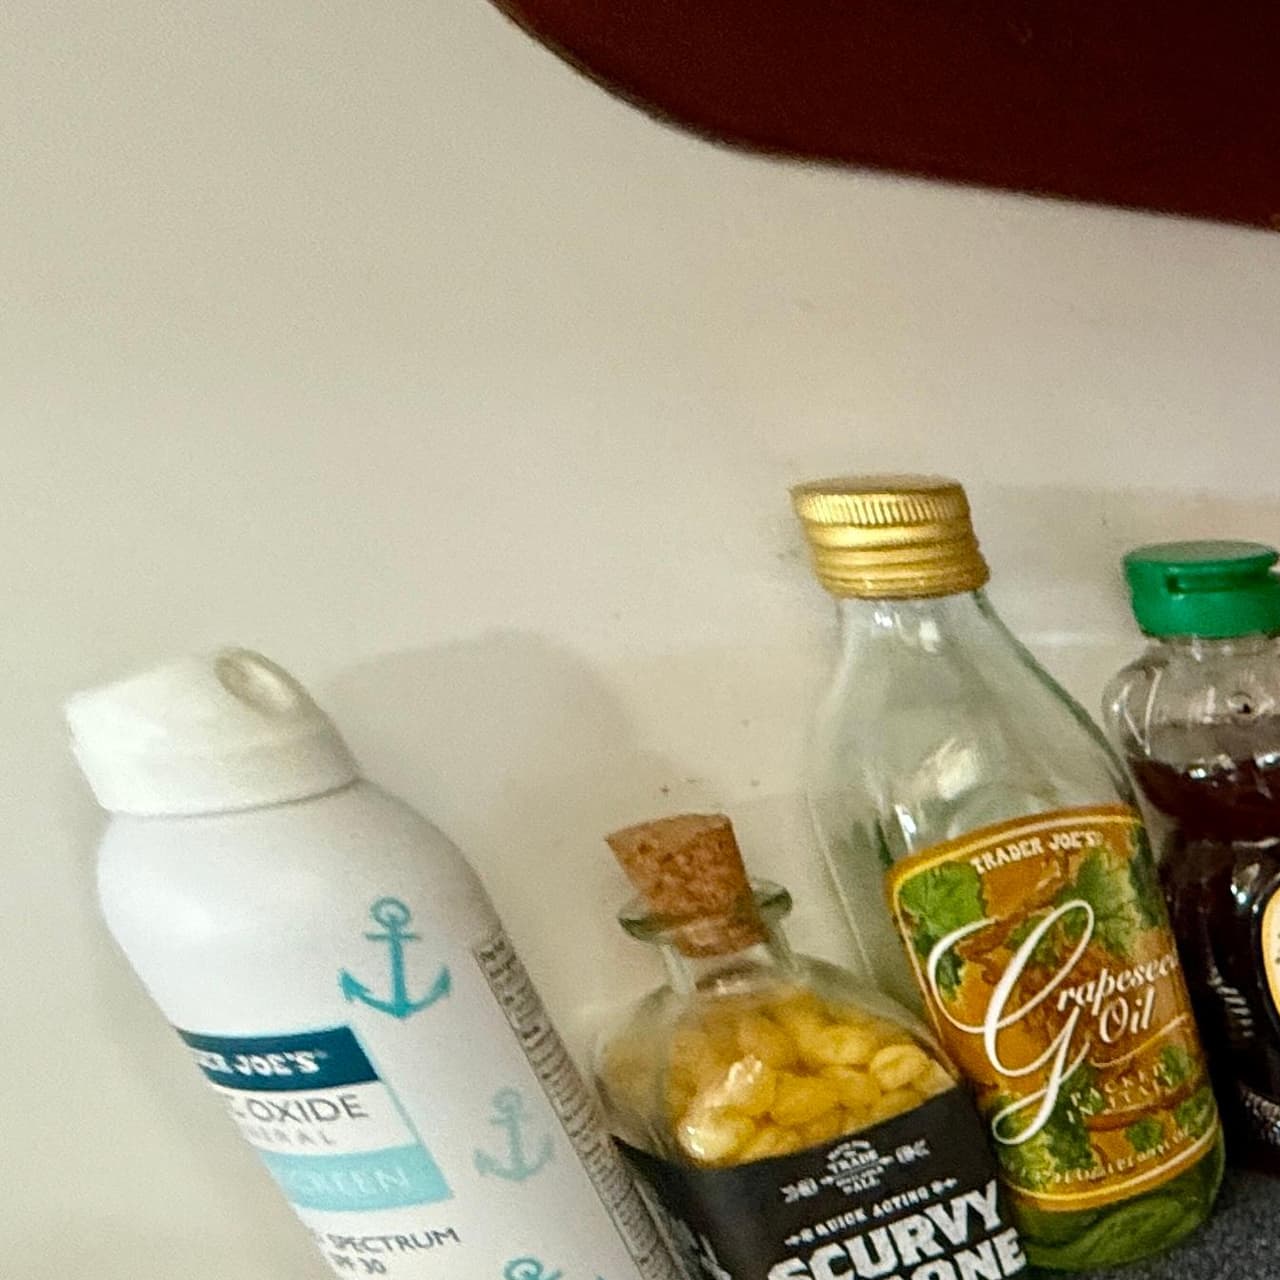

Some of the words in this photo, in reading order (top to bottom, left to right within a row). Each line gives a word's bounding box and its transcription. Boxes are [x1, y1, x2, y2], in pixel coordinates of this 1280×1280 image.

[969, 836, 1045, 875] TRADER
[1049, 831, 1096, 850] JOE'S
[928, 899, 1178, 1145] Grapesee
[1100, 986, 1156, 1044] Oil
[234, 1050, 322, 1077] JOE'S
[1070, 1062, 1167, 1108] PACKED
[246, 1094, 369, 1124] OXIDE
[1066, 1104, 1095, 1125] IN
[1109, 1074, 1173, 1109] ITALY
[815, 1207, 868, 1237] QUICK
[872, 1185, 930, 1218] ACTING
